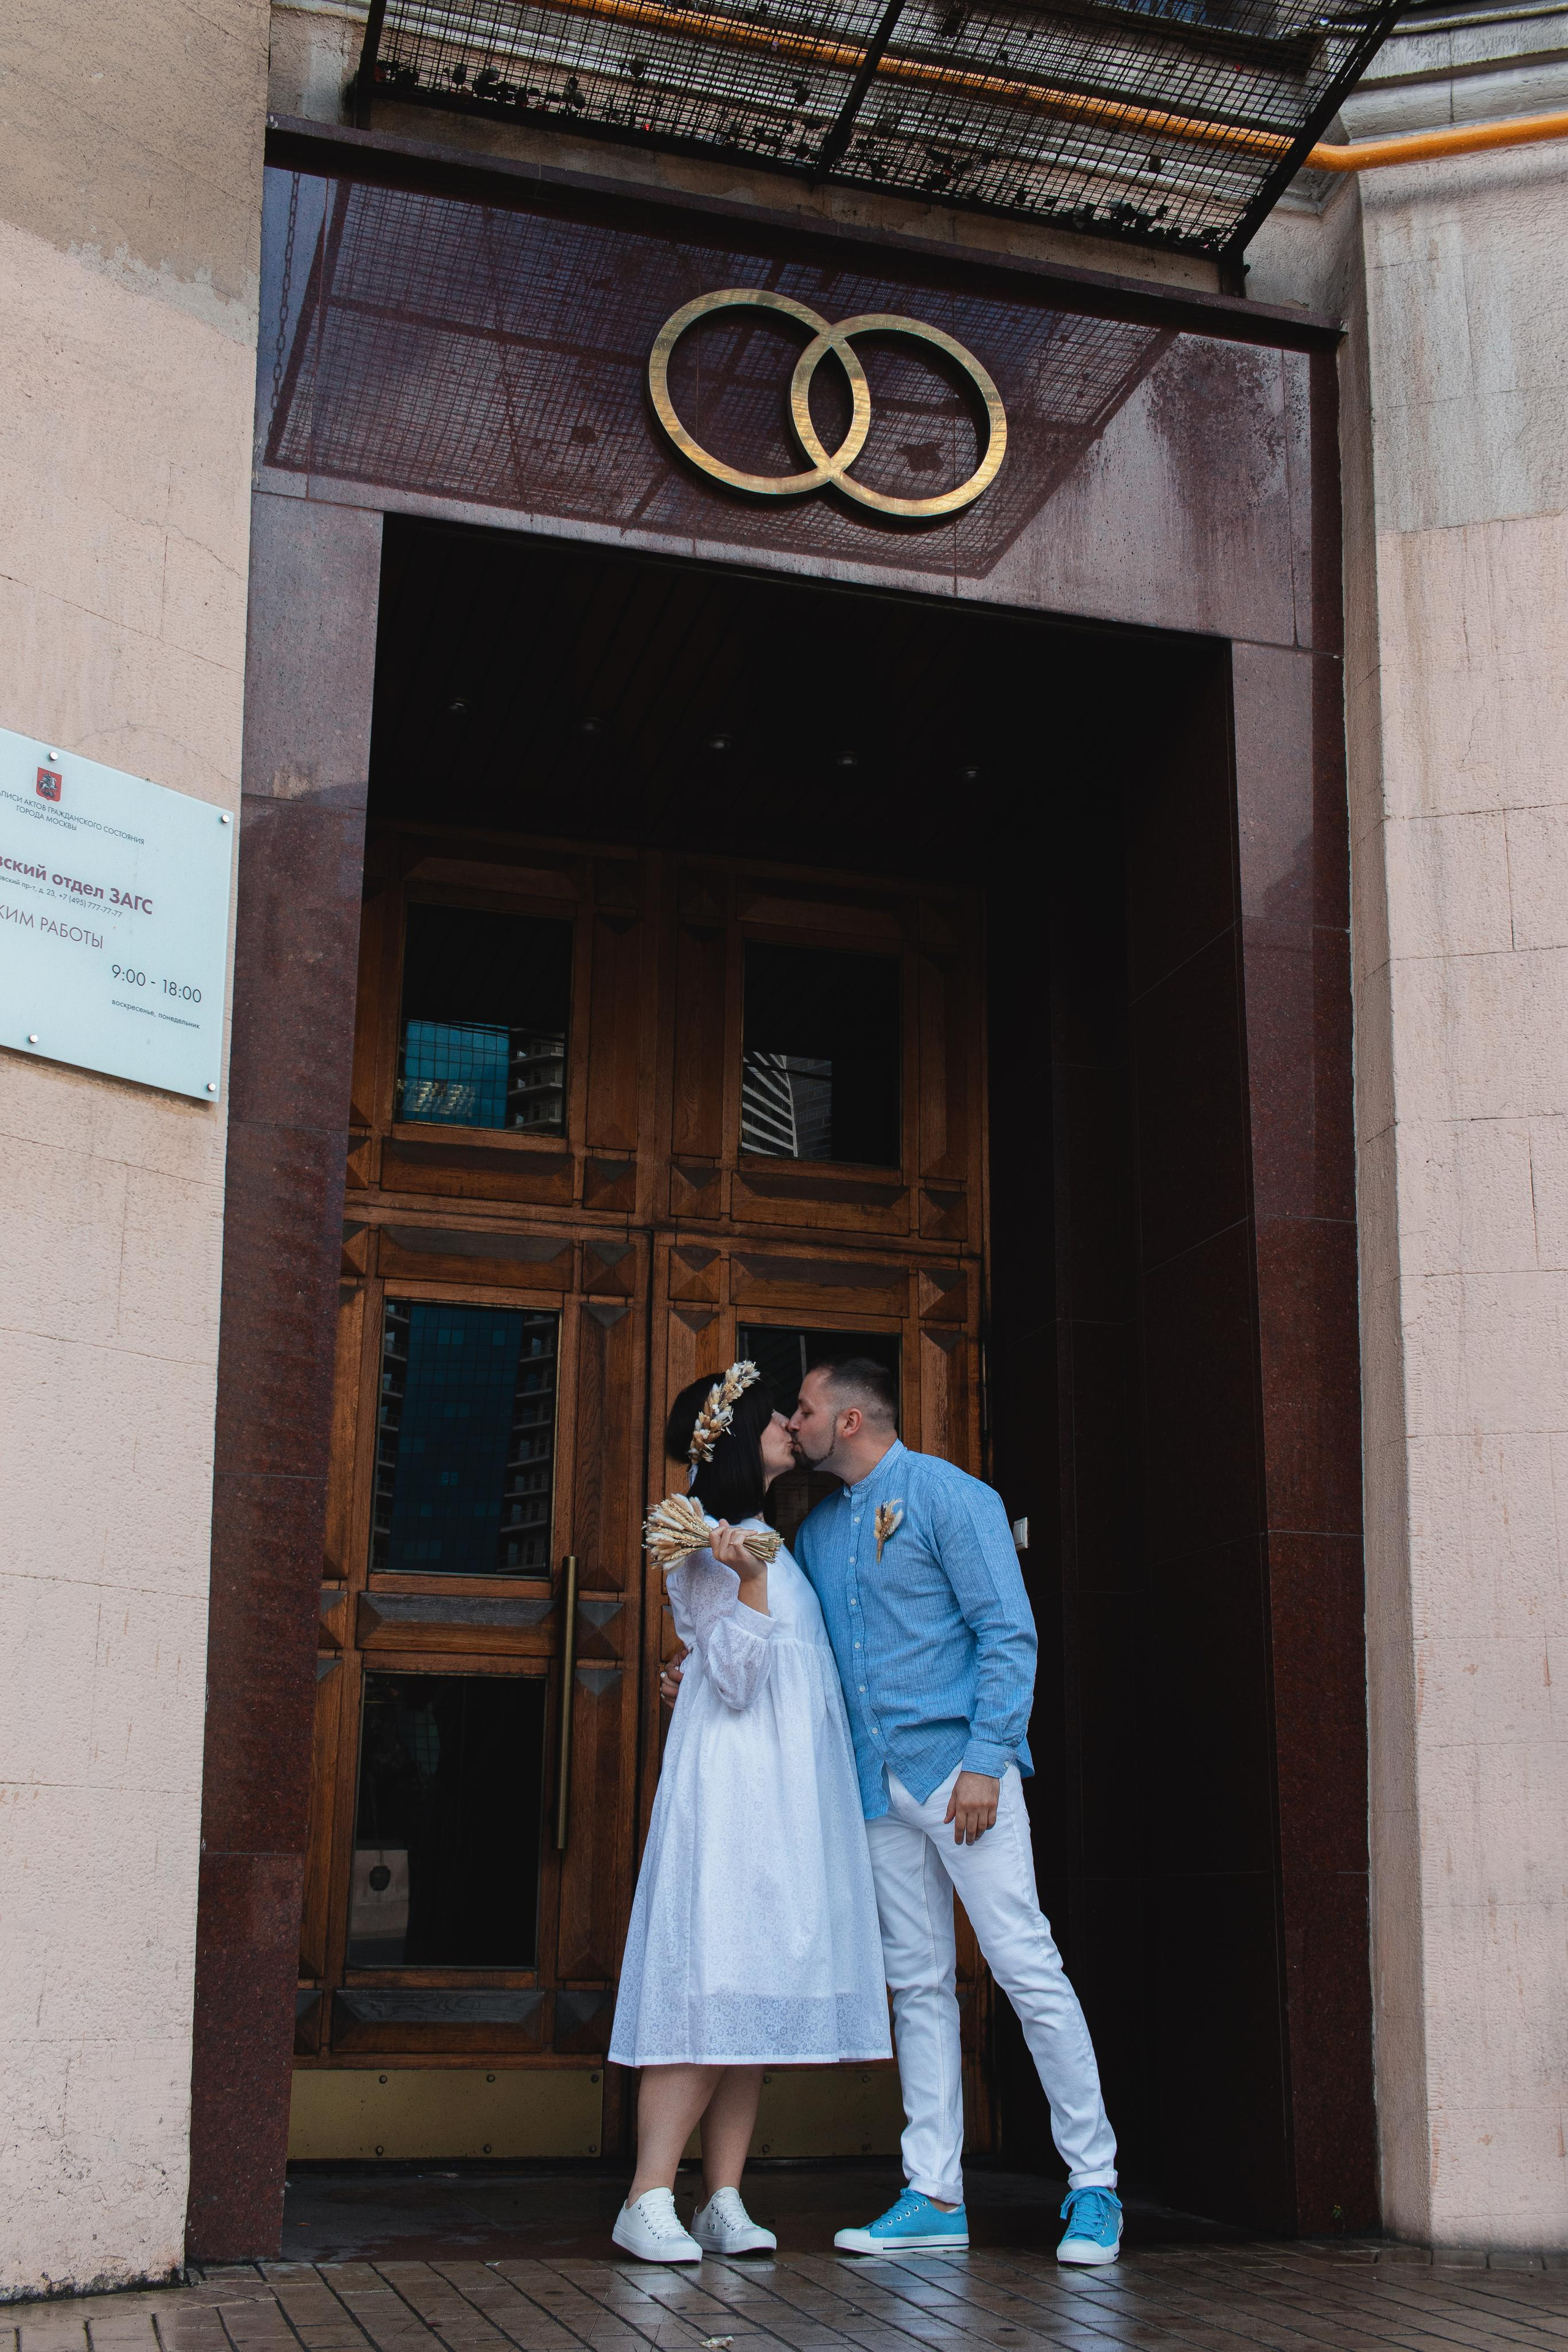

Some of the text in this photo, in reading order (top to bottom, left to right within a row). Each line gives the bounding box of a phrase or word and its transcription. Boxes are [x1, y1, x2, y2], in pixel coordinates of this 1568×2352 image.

[16, 805, 77, 831] ГОРОДА МОСКВЫ
[24, 799, 47, 812] АКТОВ
[48, 806, 102, 831] ГРАЖДАНСКОГО
[103, 826, 145, 845] СОСТОЯНИЯ
[21, 881, 37, 892] пр-т,
[47, 889, 57, 899] 23,
[69, 895, 86, 908] (495)
[88, 902, 123, 918] 777-77-77
[52, 873, 104, 900] отдел
[109, 888, 154, 915] ЗАГС
[40, 916, 104, 949] РАБОТЫ
[111, 964, 146, 987] 9:00
[163, 979, 202, 1003] 18:00
[111, 999, 200, 1030] воскресенье, понедельник
